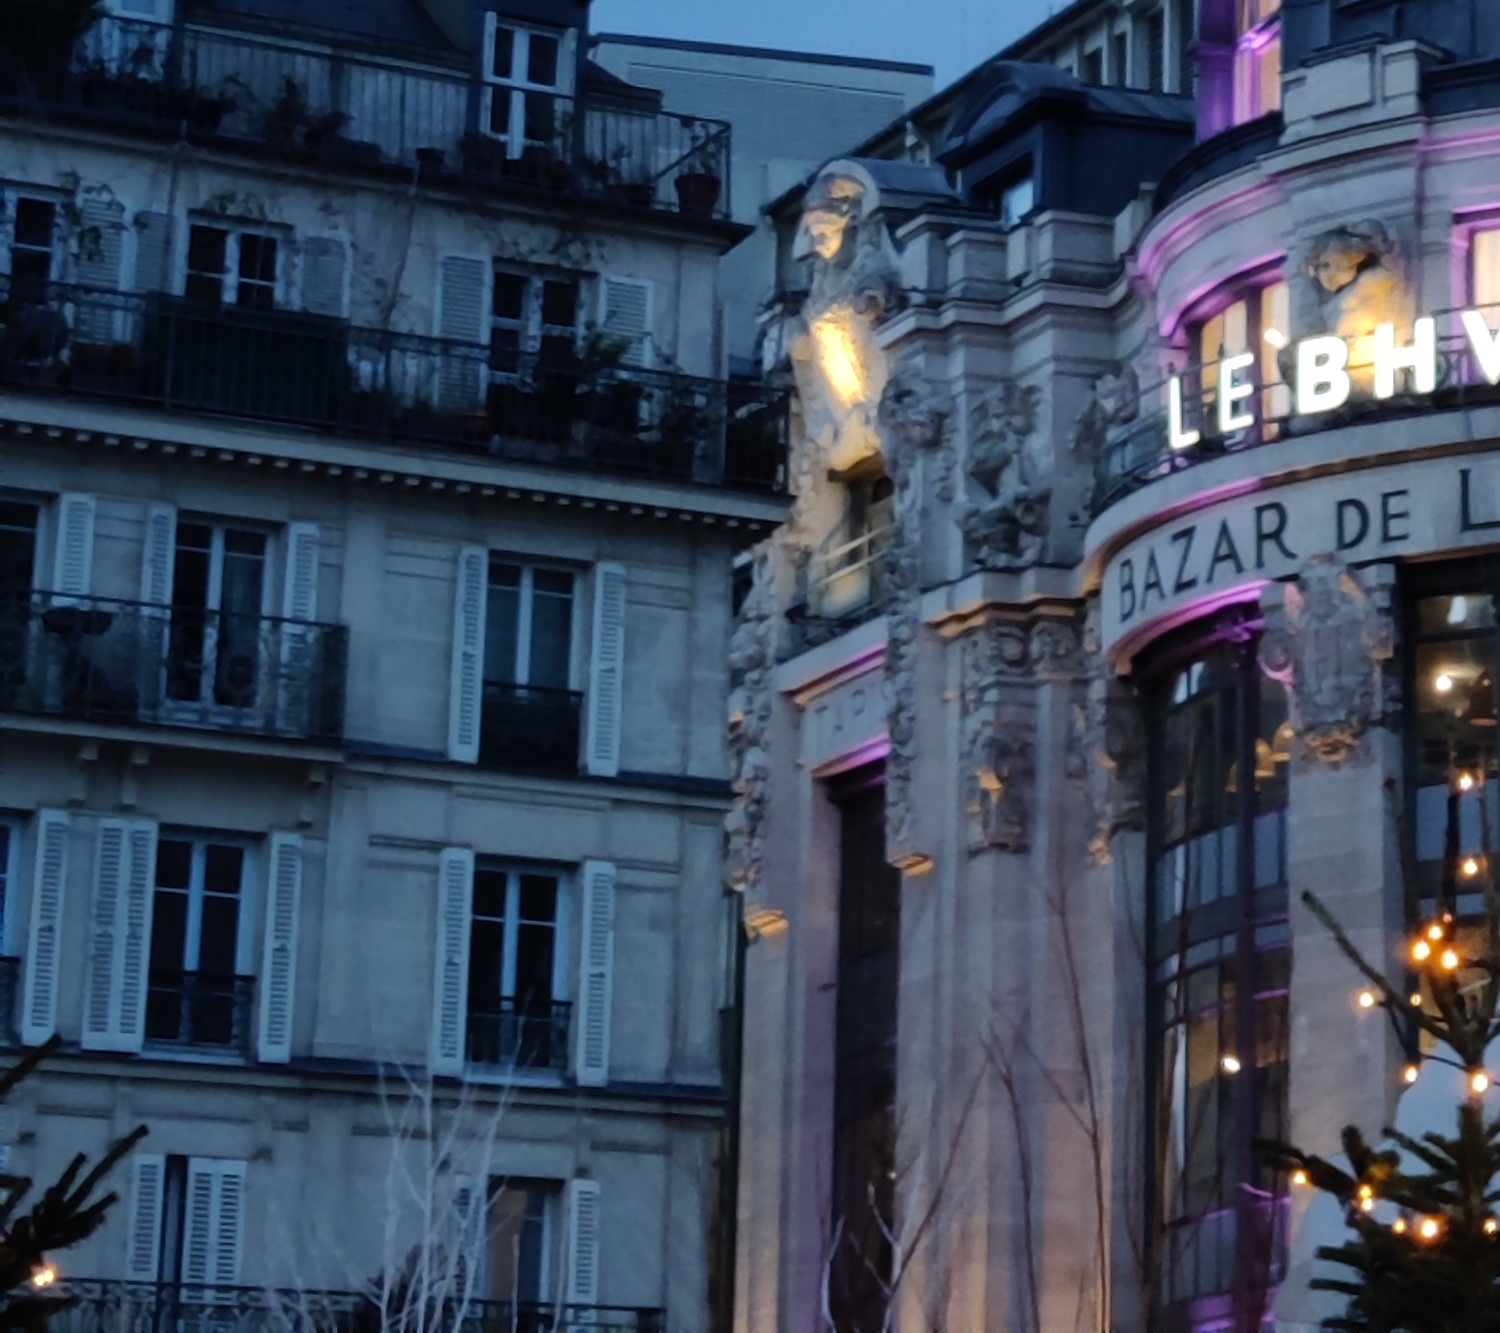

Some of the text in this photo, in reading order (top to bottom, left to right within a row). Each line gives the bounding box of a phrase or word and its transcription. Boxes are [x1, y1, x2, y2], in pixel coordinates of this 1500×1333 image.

[1167, 351, 1255, 450] LE
[1118, 501, 1298, 624] BAZAR
[1334, 489, 1410, 553] DE
